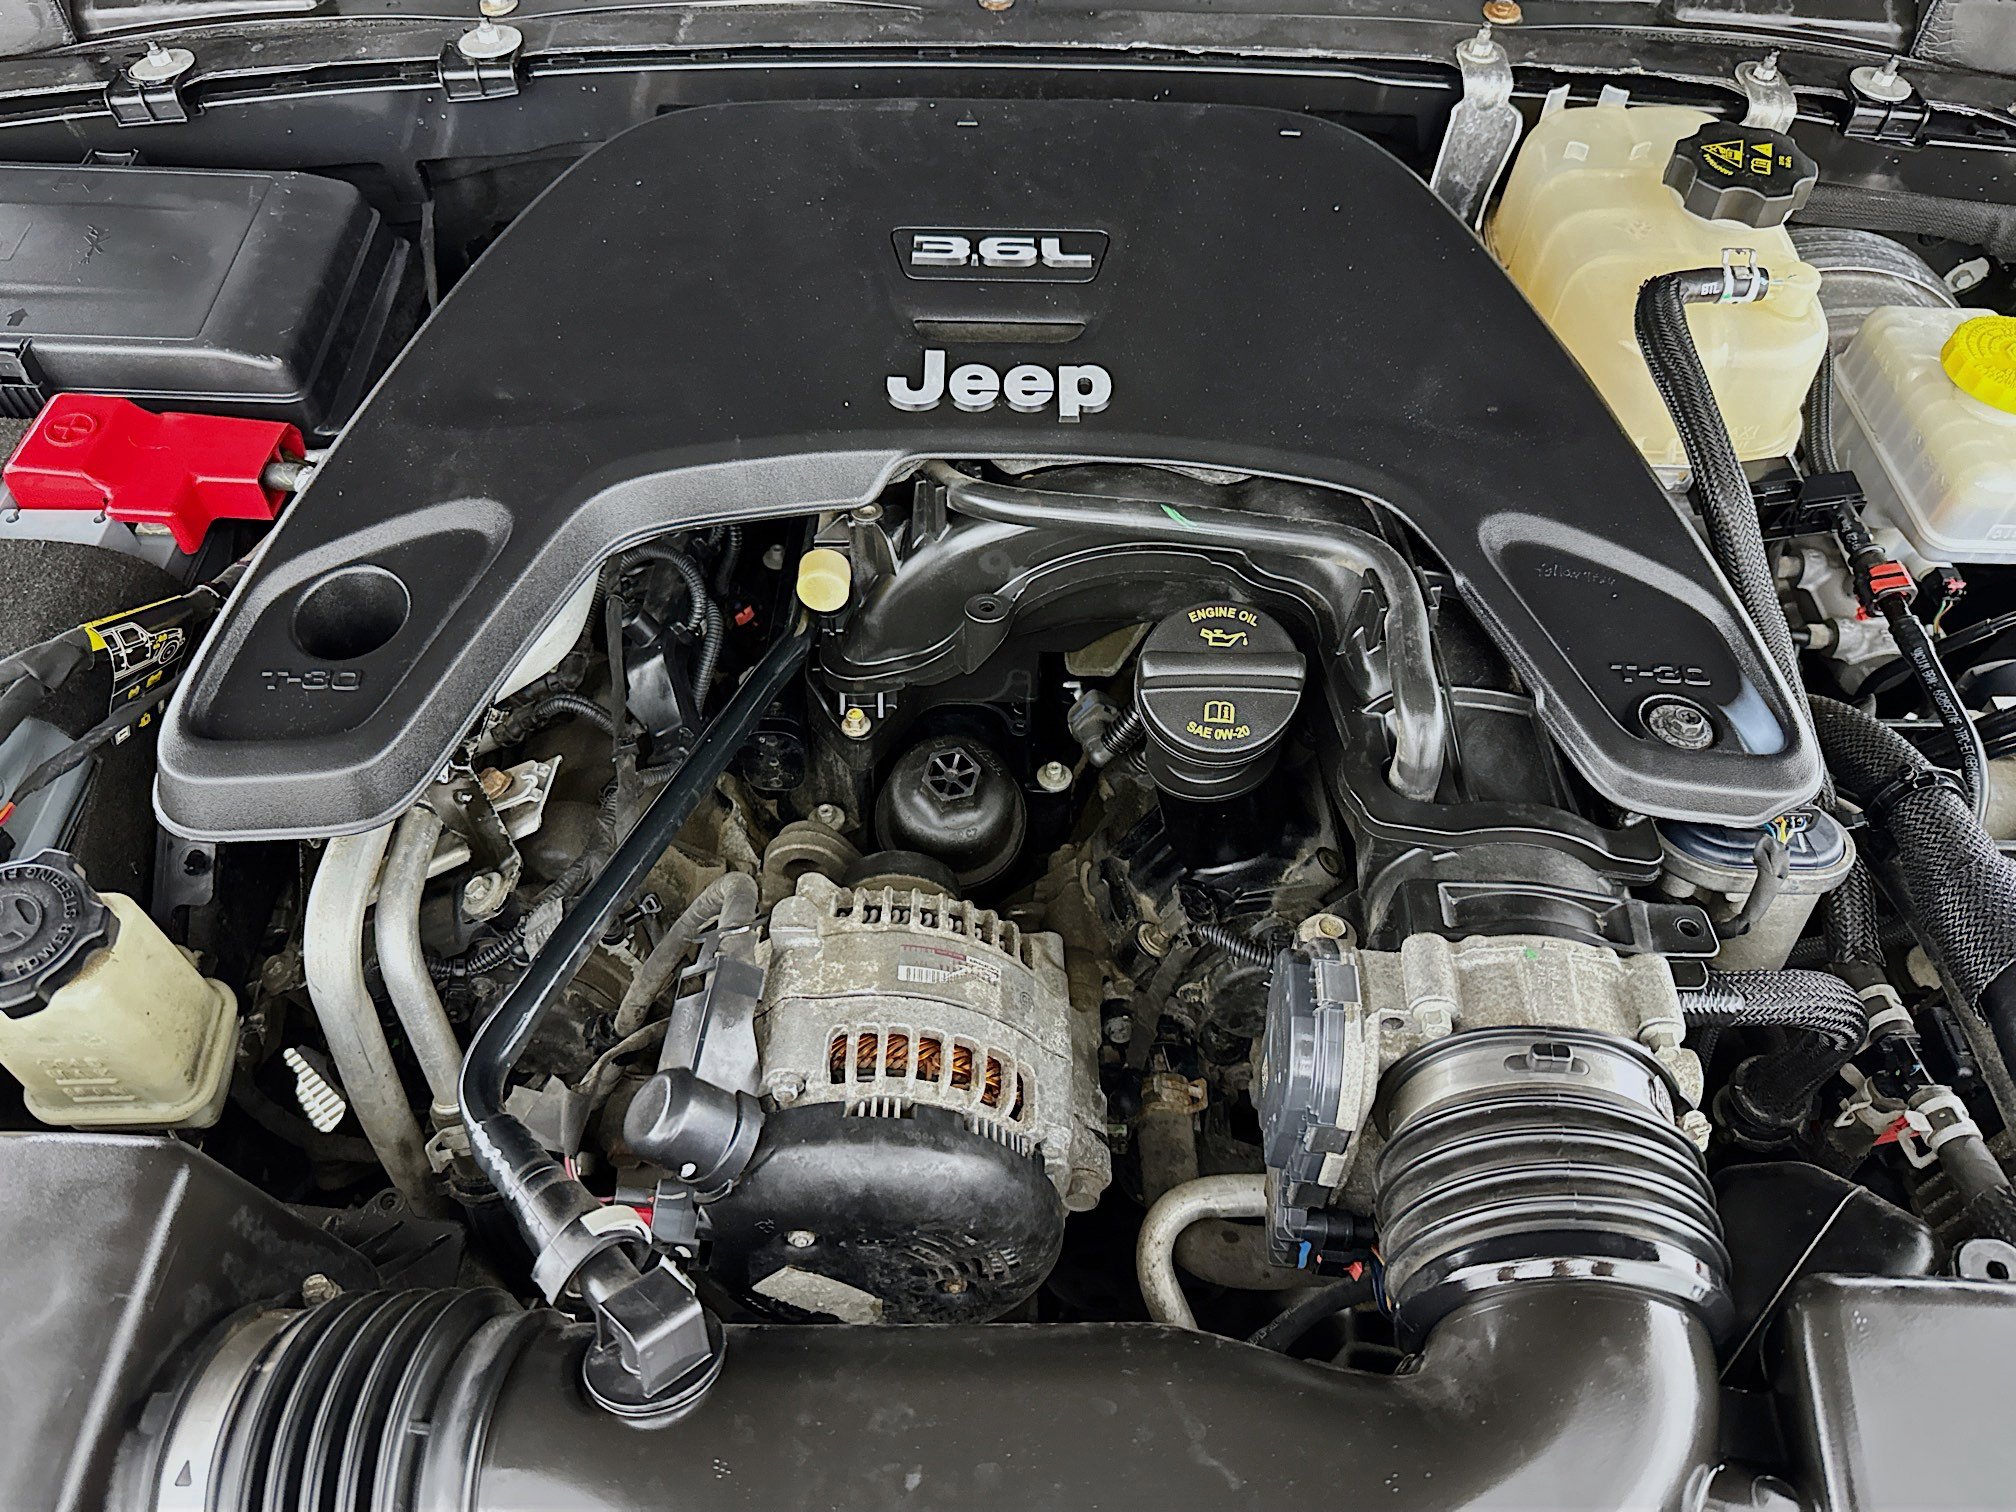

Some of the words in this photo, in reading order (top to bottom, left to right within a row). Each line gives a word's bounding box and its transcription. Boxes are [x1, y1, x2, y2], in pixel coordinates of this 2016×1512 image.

[911, 235, 1093, 268] 3.6L
[886, 349, 1112, 423] Jeep
[1188, 606, 1237, 624] ENGINE
[1239, 610, 1258, 627] OIL
[261, 670, 361, 691] T-30
[1186, 720, 1213, 739] SAE
[1214, 725, 1250, 740] 0W-20
[24, 867, 77, 919] STEERING
[14, 922, 73, 975] POWER
